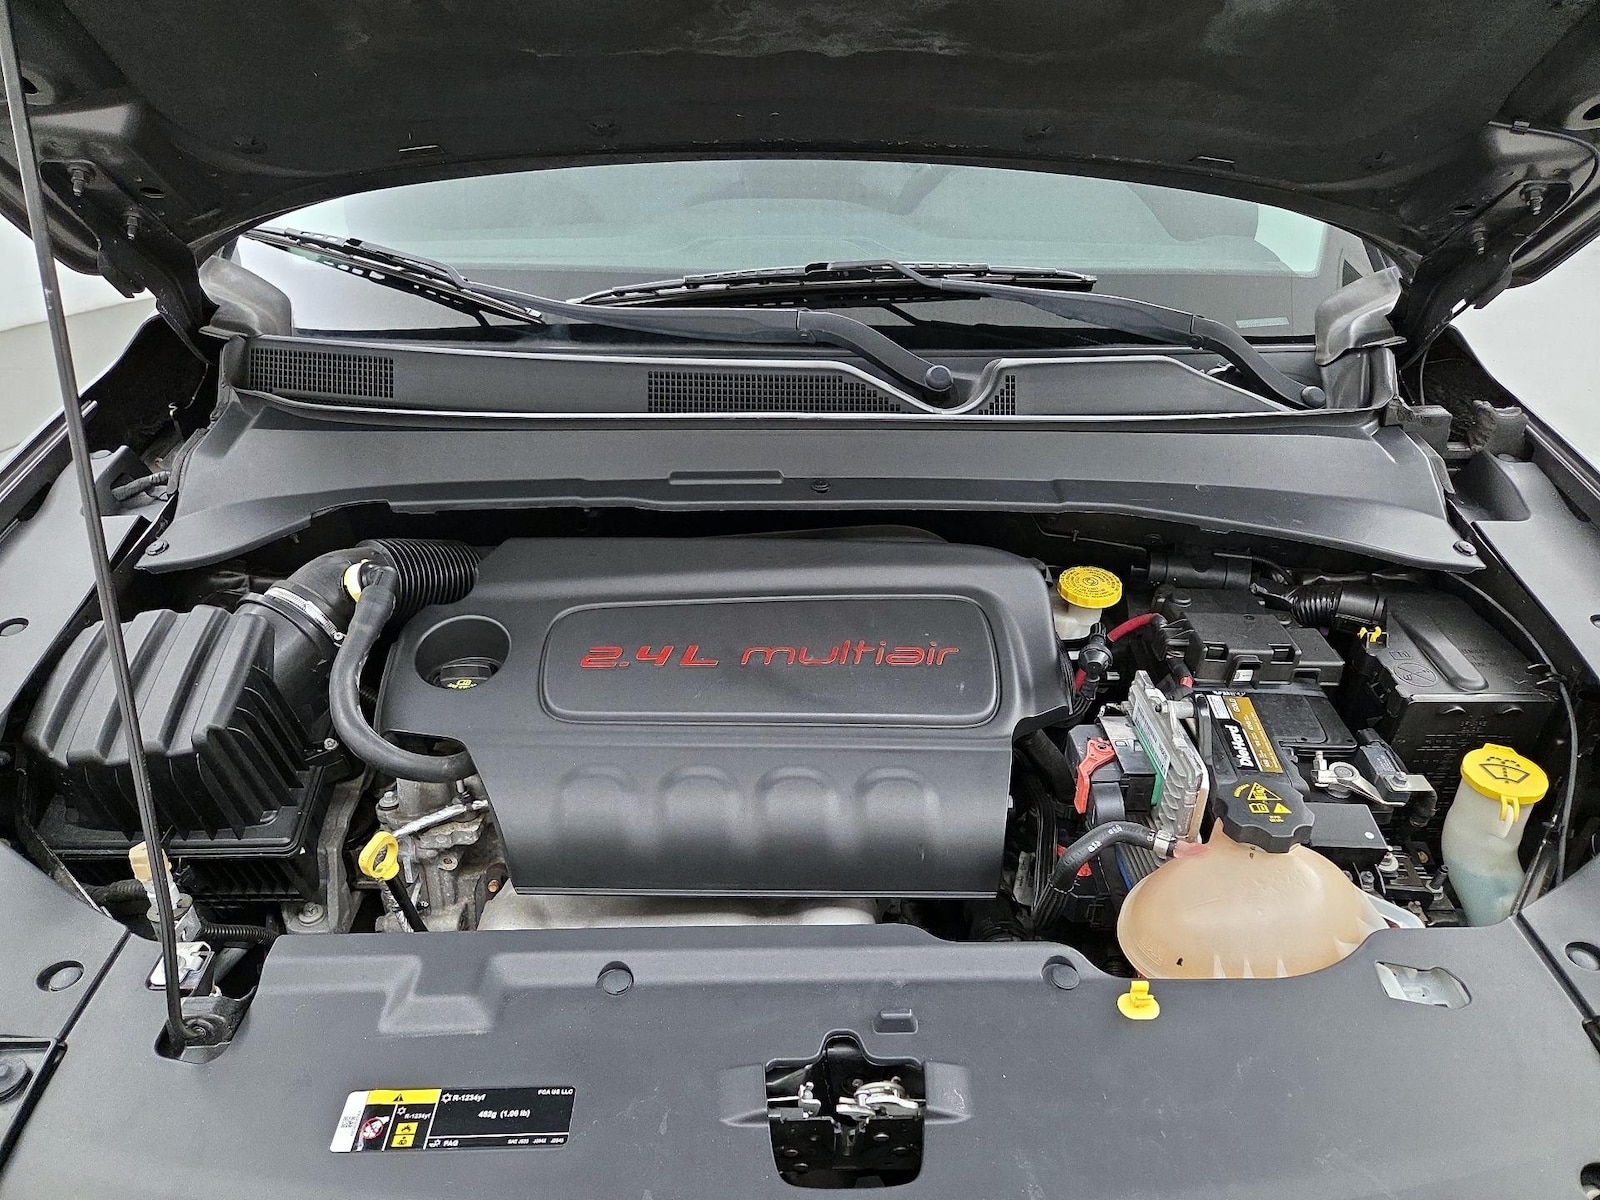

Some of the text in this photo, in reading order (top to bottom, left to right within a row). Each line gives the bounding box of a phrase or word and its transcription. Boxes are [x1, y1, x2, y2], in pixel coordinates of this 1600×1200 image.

[741, 640, 960, 667] multiair
[1224, 724, 1254, 767] DieHard
[452, 1093, 487, 1103] R-1234yf
[443, 1139, 459, 1147] PAG
